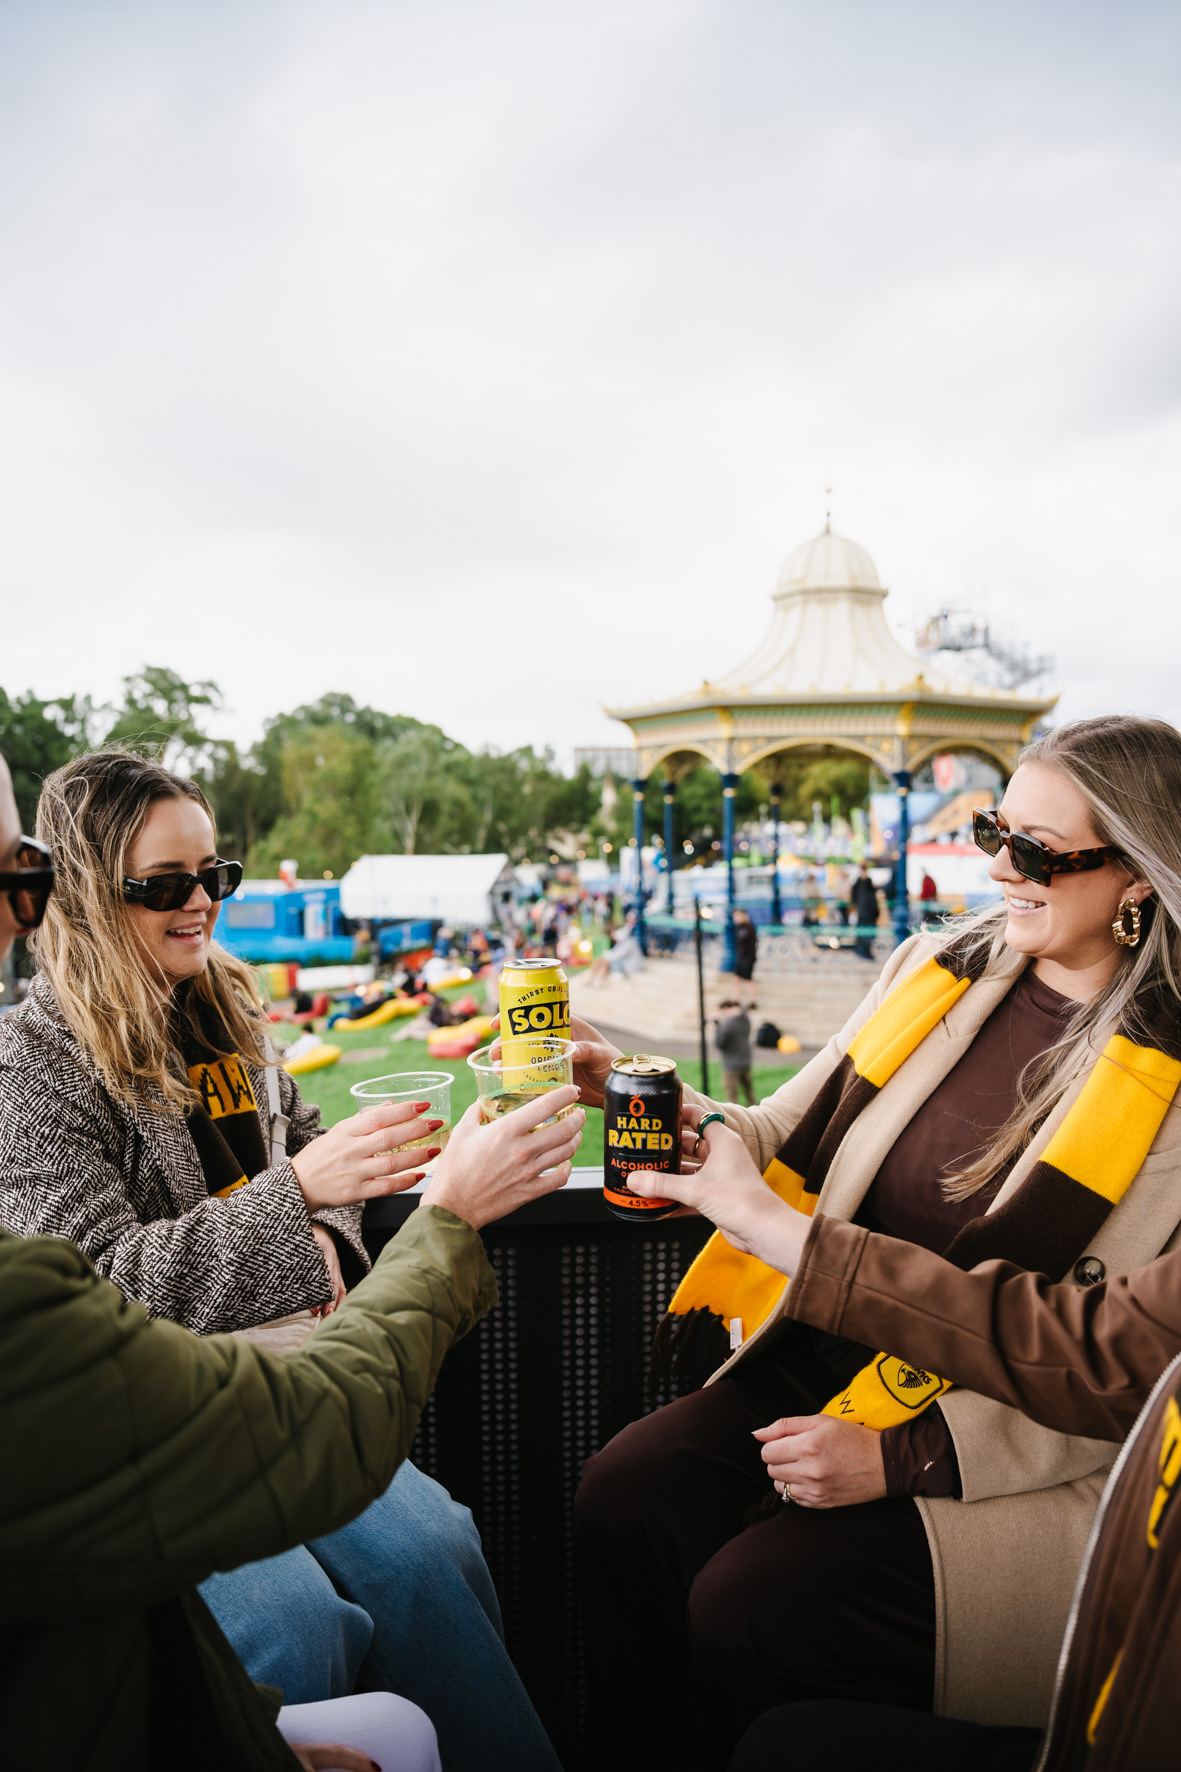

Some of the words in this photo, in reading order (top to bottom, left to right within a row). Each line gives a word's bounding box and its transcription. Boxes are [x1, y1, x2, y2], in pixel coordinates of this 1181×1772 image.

[518, 987, 544, 1004] THIRST
[617, 1116, 663, 1130] HARD
[608, 1129, 673, 1150] RATED
[611, 1158, 670, 1171] ALCOHOLIC
[628, 1200, 649, 1208] 4.5%
